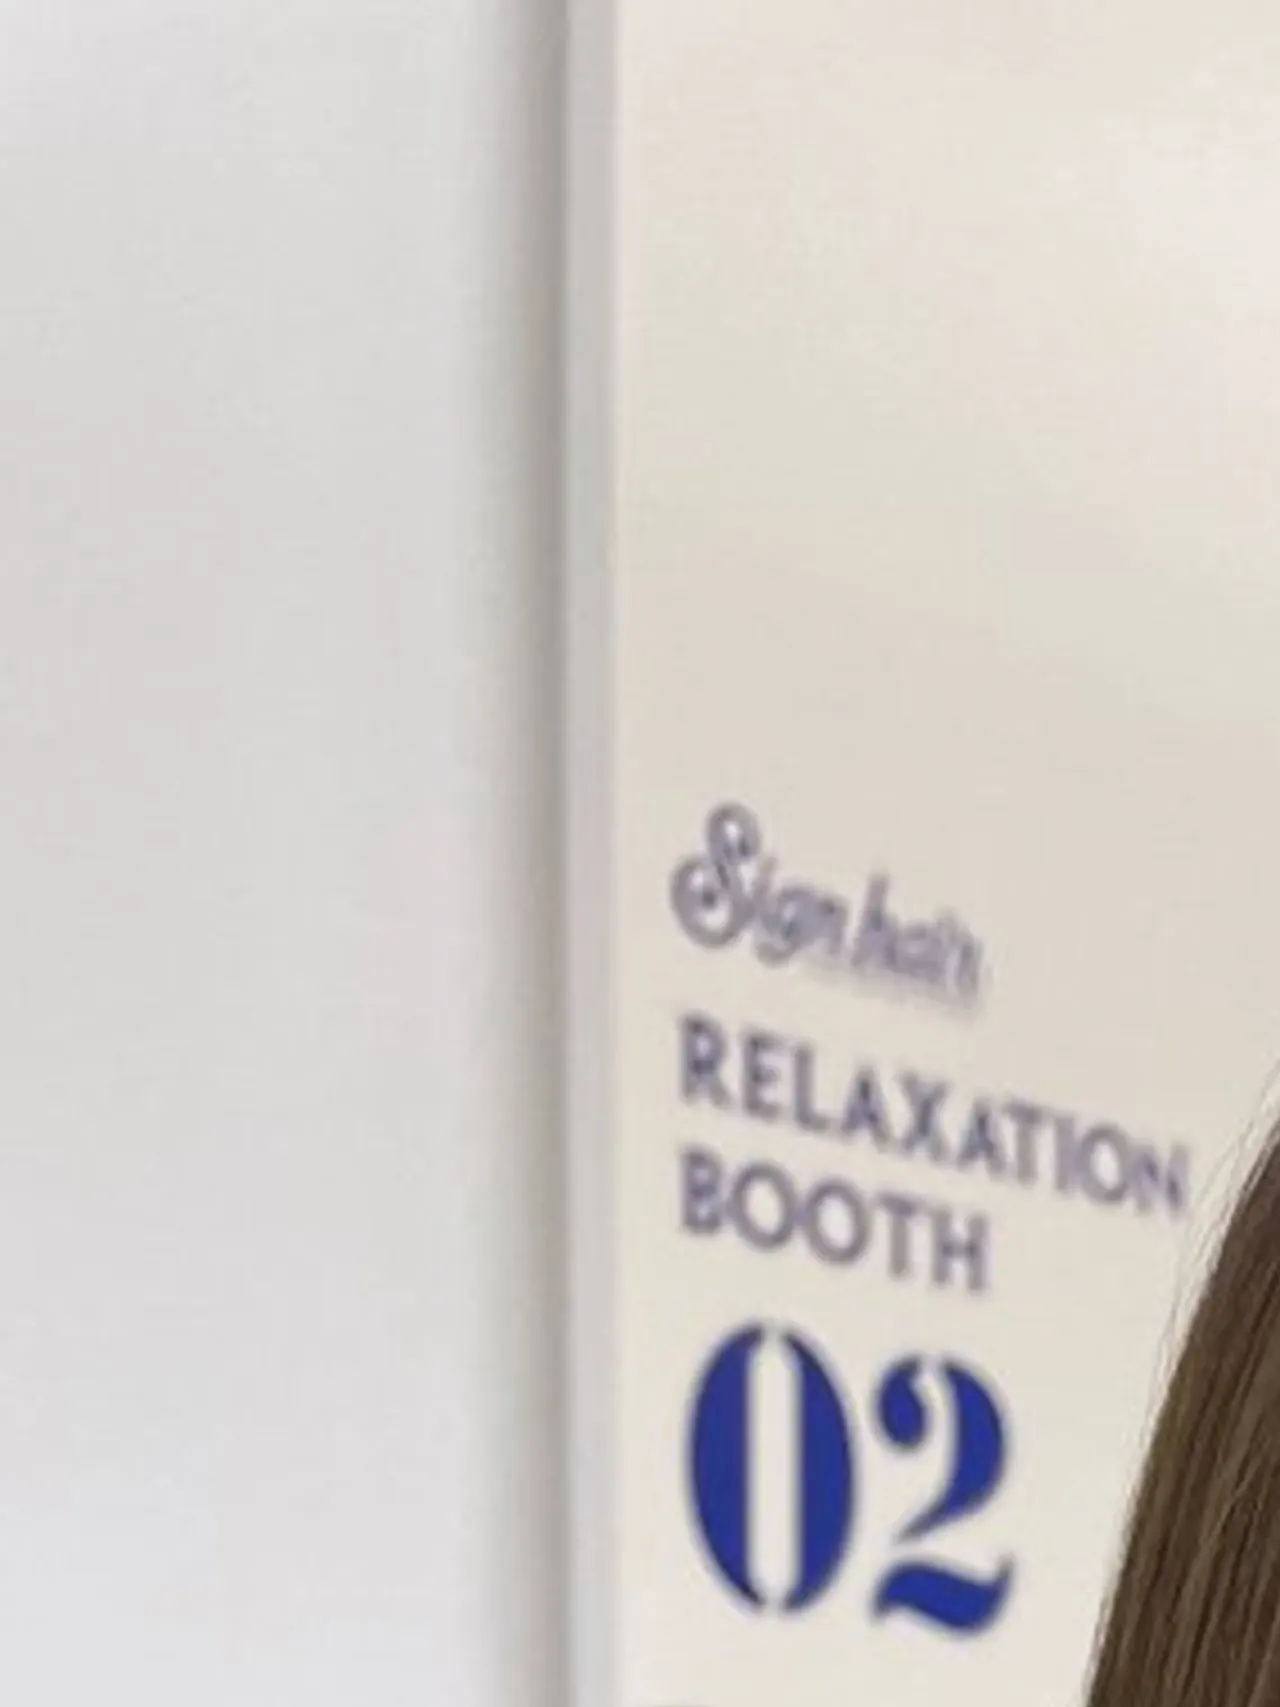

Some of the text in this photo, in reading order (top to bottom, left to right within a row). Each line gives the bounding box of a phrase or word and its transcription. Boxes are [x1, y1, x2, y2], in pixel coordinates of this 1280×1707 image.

[669, 802, 848, 966] Sign
[679, 1012, 1192, 1215] RELAXATION
[679, 1147, 990, 1292] BOOTH
[687, 1321, 1016, 1637] 02
